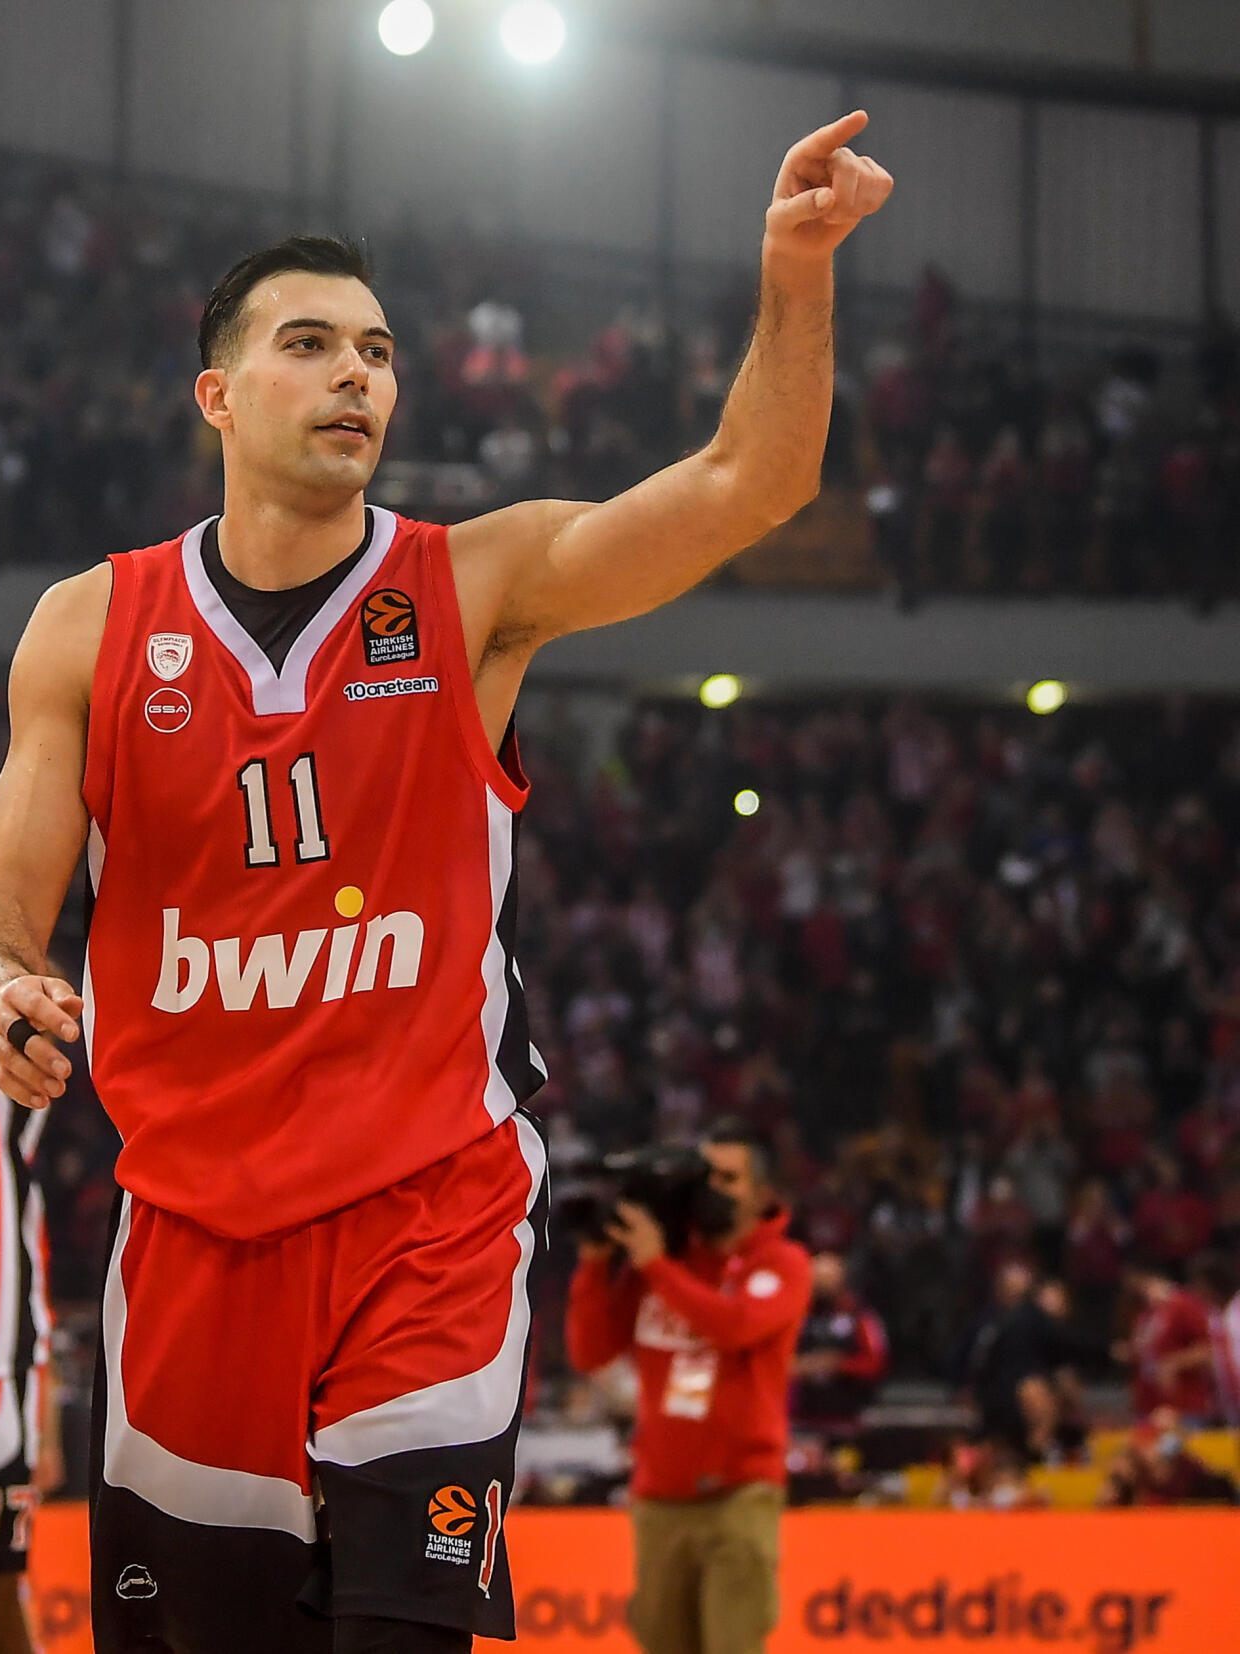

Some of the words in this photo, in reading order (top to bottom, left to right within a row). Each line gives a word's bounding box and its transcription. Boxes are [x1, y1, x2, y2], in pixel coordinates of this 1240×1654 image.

[369, 634, 414, 648] TURKISH
[370, 642, 415, 656] AIRLINES
[370, 651, 415, 663] EuroLeague
[148, 705, 187, 714] GSA
[237, 752, 330, 869] 11
[151, 886, 424, 1013] bwin
[428, 1534, 471, 1548] TURKISH
[426, 1543, 470, 1557] AIRLINES
[425, 1551, 469, 1565] EuroLeague
[805, 1575, 1171, 1654] deddie.gr
